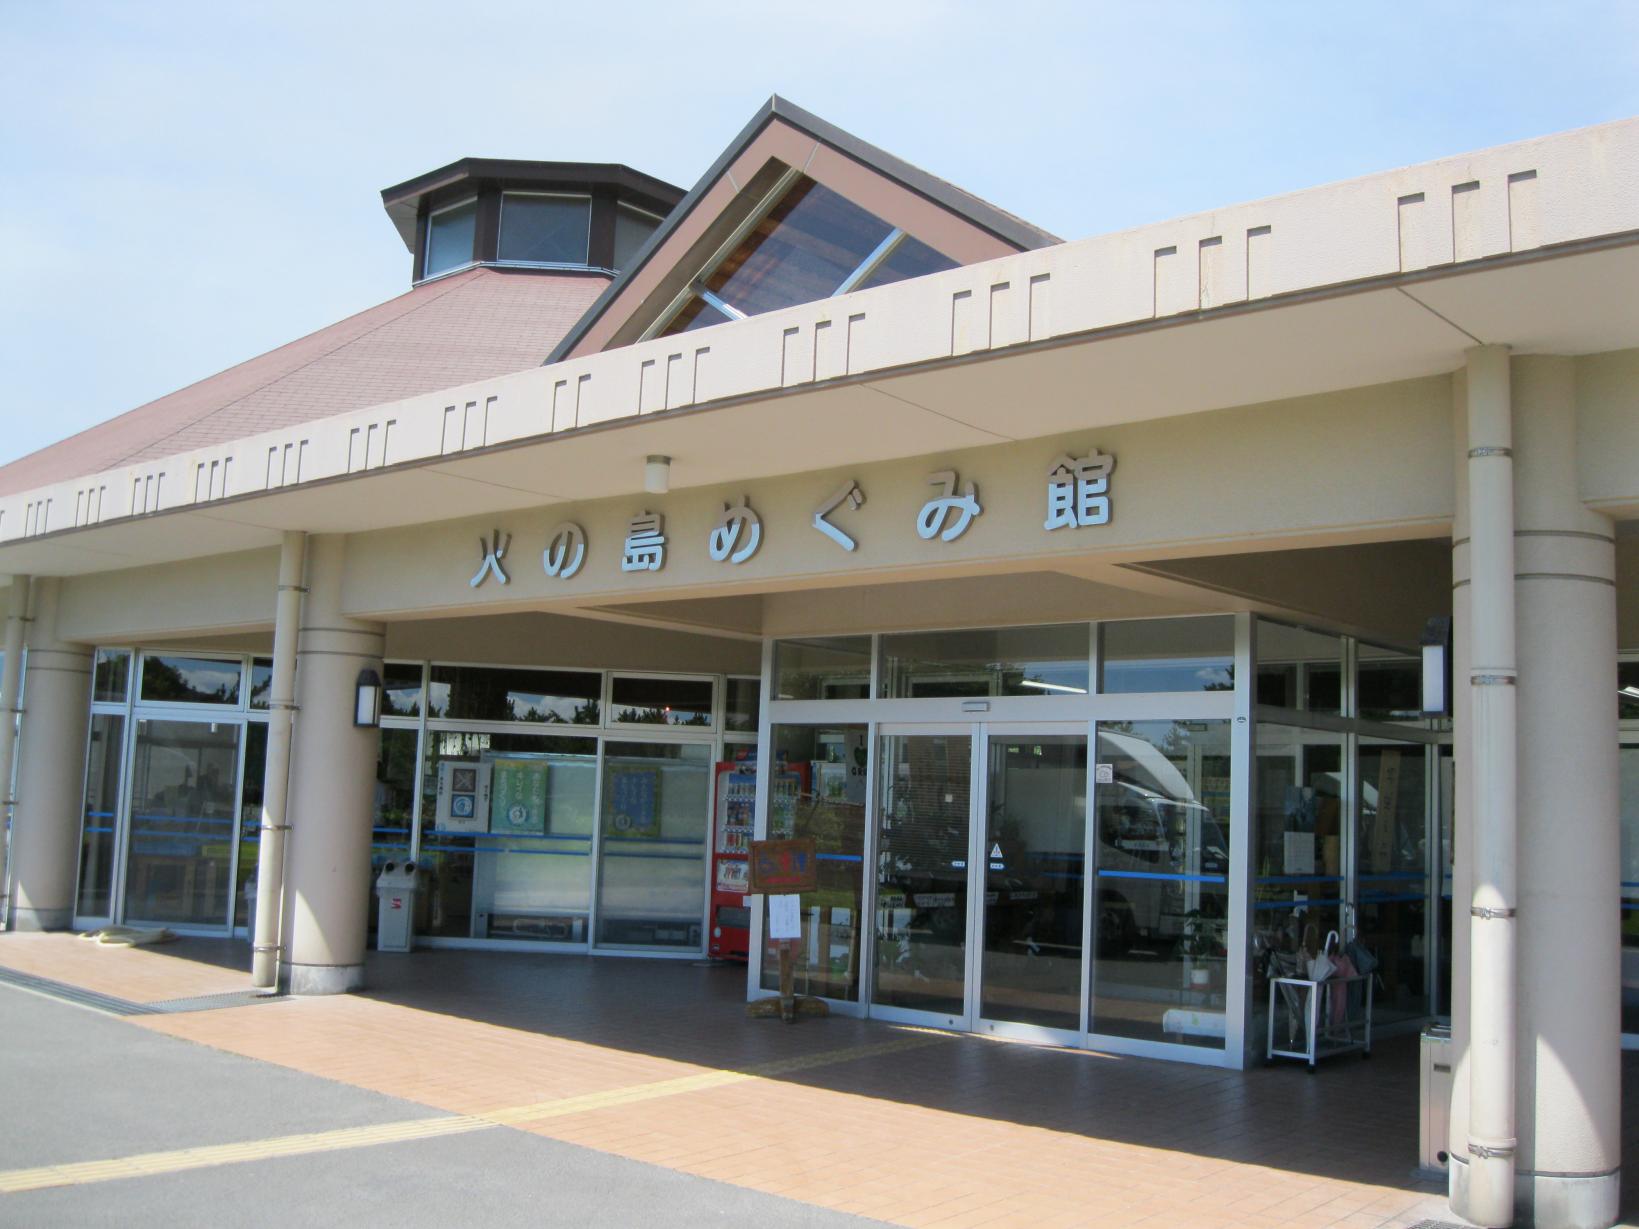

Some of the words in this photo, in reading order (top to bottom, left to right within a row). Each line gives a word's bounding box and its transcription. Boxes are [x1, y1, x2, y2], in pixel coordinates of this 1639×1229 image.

[470, 449, 1115, 588] 火の島めぐみ館
